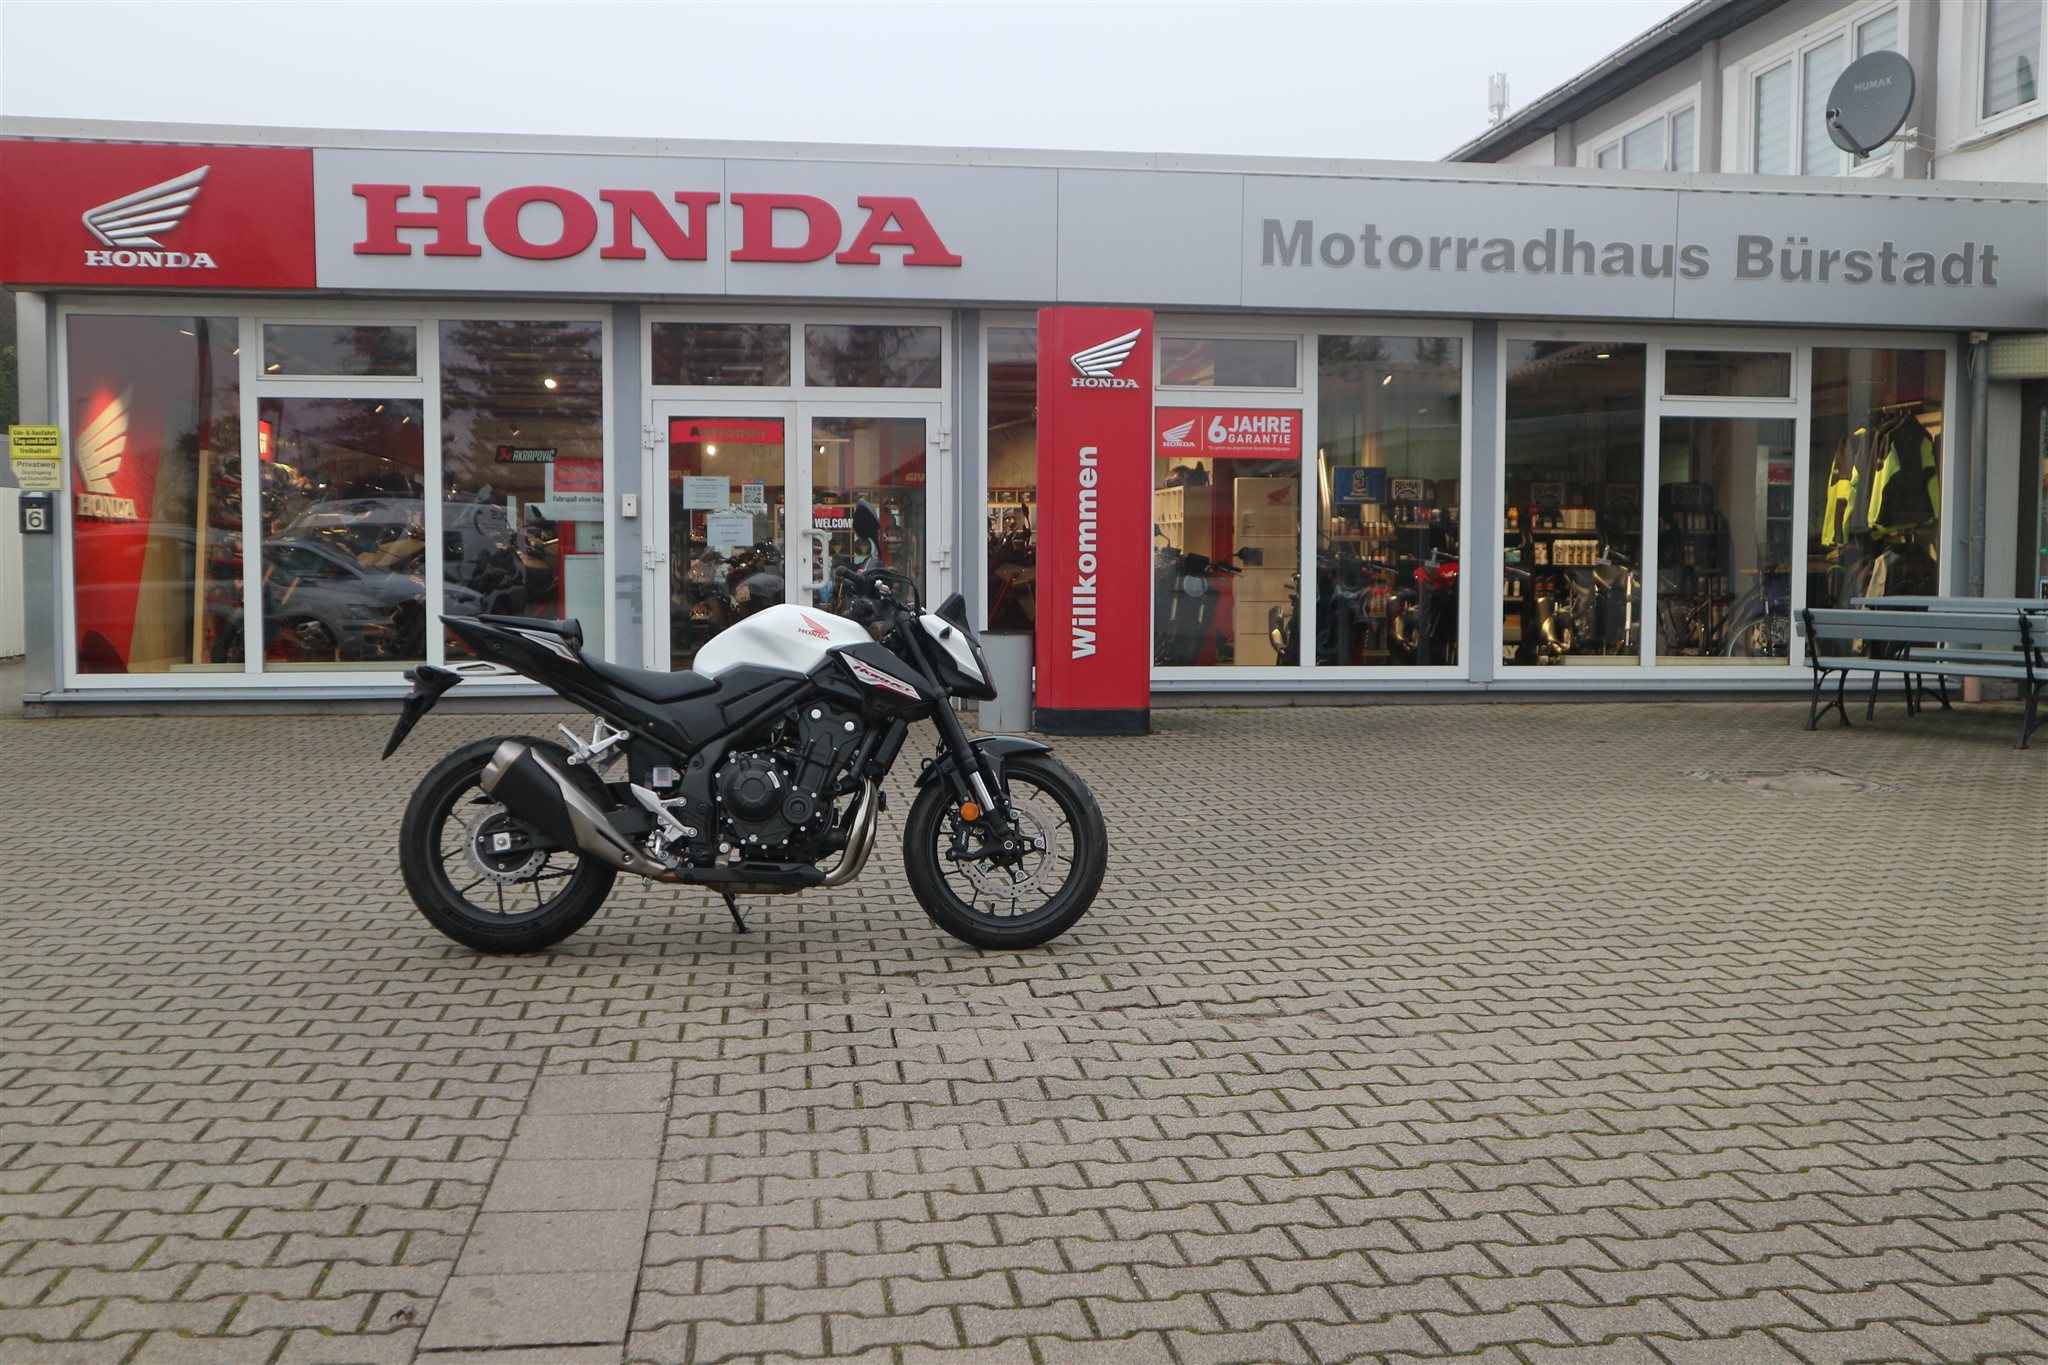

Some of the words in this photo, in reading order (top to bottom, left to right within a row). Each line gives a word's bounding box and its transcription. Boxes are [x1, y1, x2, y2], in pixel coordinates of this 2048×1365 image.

[1853, 76, 1892, 92] HUMAX
[351, 183, 963, 267] HONDA
[84, 250, 219, 269] HONDA
[1261, 217, 1711, 280] Motorradhaus
[1734, 233, 1999, 288] Bürstadt
[1071, 377, 1140, 389] HONDA
[31, 429, 57, 437] Ausfahrt
[1208, 415, 1227, 443] 6
[1228, 433, 1291, 445] GARANTIE
[16, 461, 56, 469] Privatweg
[77, 493, 139, 520] HONDA
[28, 511, 43, 528] 6
[1071, 446, 1099, 660] Willkommen
[798, 628, 831, 641] HONDA
